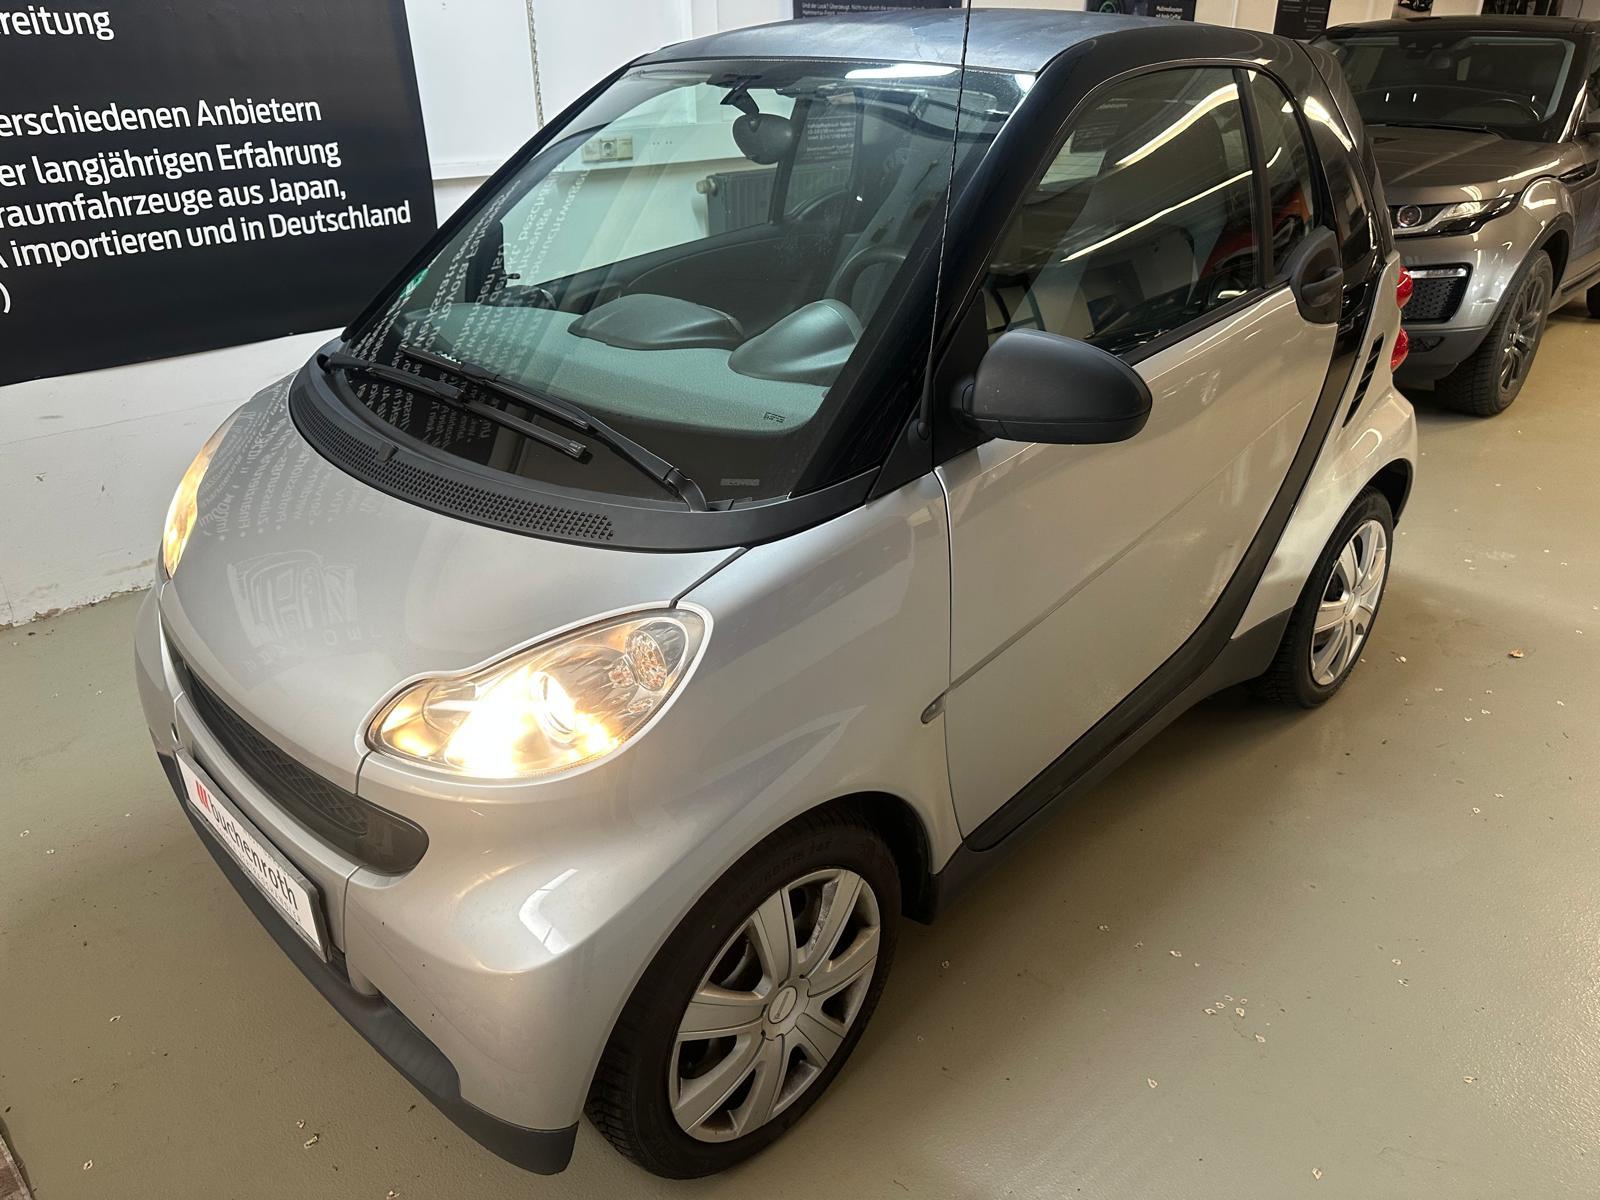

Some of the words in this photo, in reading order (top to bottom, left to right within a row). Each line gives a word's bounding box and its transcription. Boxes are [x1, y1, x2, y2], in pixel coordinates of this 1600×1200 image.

[0, 5, 115, 41] reitung
[0, 102, 191, 137] erschiedenen
[197, 98, 322, 127] Anbietern
[0, 163, 27, 187] er
[31, 148, 213, 187] langjährigen
[215, 140, 342, 178] Erfahrung
[0, 190, 213, 230] raumfahrzeuge
[217, 184, 264, 208] aus
[268, 178, 347, 211] Japan,
[10, 225, 183, 268] importieren
[186, 217, 236, 248] und
[242, 214, 265, 241] in
[268, 200, 411, 238] Deutschland
[207, 794, 298, 910] buchenroth
